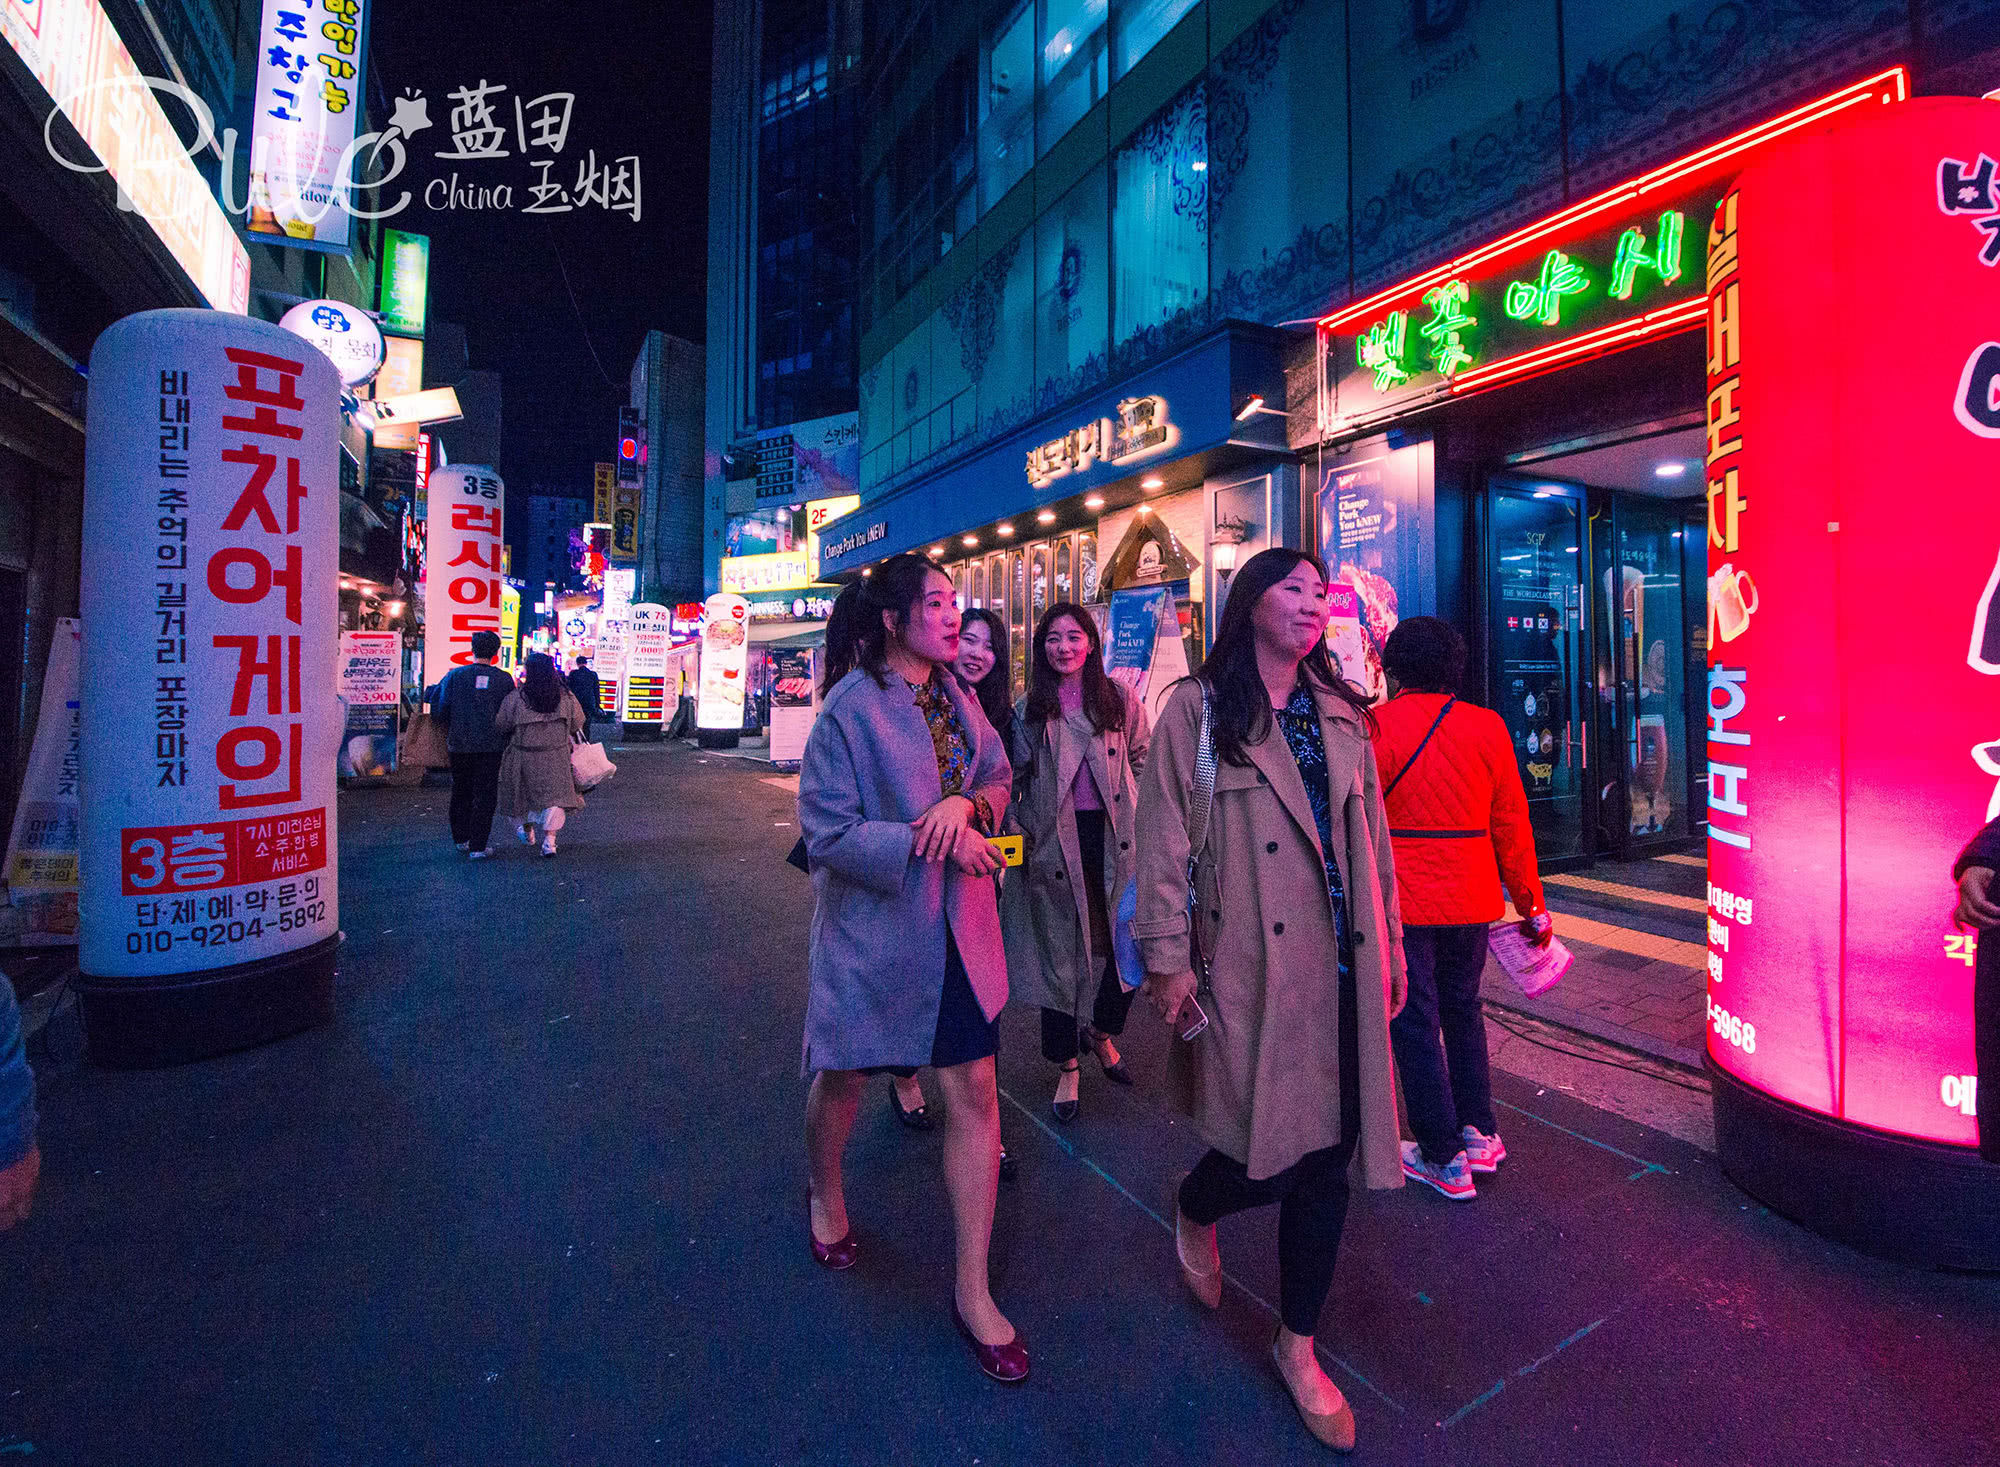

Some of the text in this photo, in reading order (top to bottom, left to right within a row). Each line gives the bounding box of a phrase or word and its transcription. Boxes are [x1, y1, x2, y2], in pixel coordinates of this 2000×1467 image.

[463, 474, 498, 500] 3층
[811, 508, 828, 525] 2F
[1339, 499, 1369, 511] Change
[1339, 508, 1360, 521] Pork
[156, 487, 190, 571] 추억의
[1339, 520, 1355, 532] You
[824, 541, 844, 560] Change
[843, 534, 856, 552] Pork
[855, 530, 867, 547] You
[206, 346, 309, 811] 포차어게인
[155, 582, 188, 665] 길거리
[635, 610, 651, 620] UK
[655, 611, 667, 621] 75
[155, 676, 190, 788] 포장마차
[246, 822, 272, 841] 7시
[129, 828, 228, 889] 3층
[271, 851, 310, 874] 서비스
[1707, 881, 1753, 926] 대환영
[126, 900, 326, 955] 010-9204-5892
